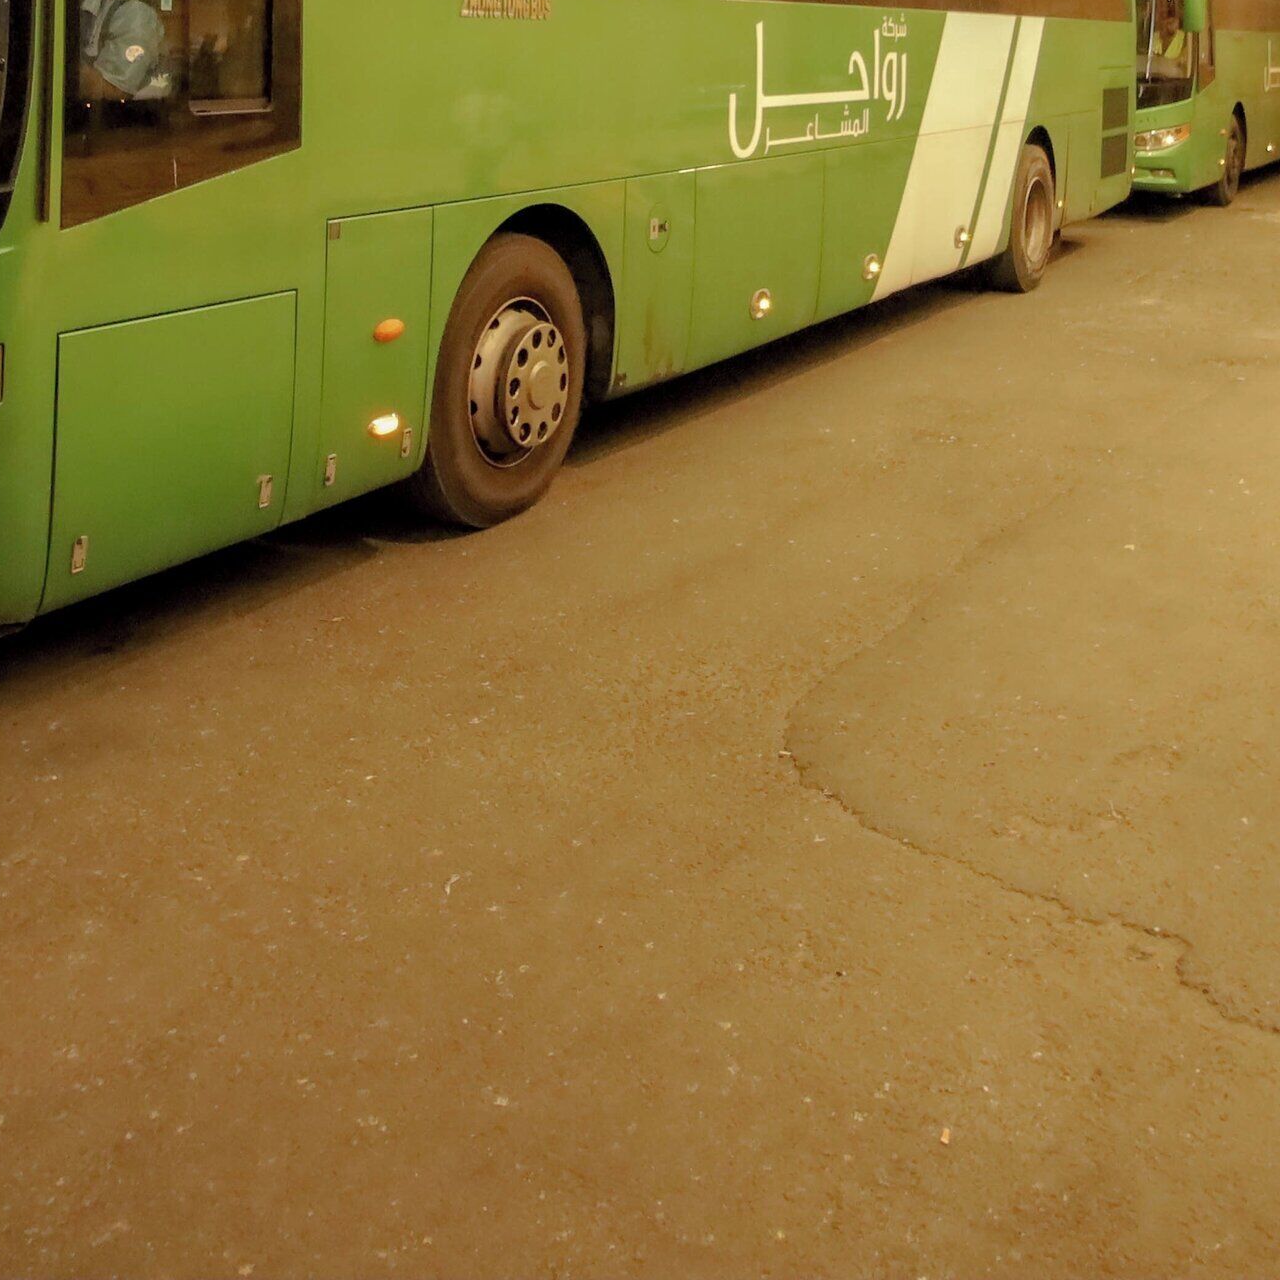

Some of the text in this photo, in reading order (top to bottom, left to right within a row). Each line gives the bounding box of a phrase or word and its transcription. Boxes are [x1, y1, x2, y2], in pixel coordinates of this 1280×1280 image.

[882, 13, 907, 42] شركة
[729, 20, 907, 159] رواحل
[764, 104, 870, 155] المشاعر
